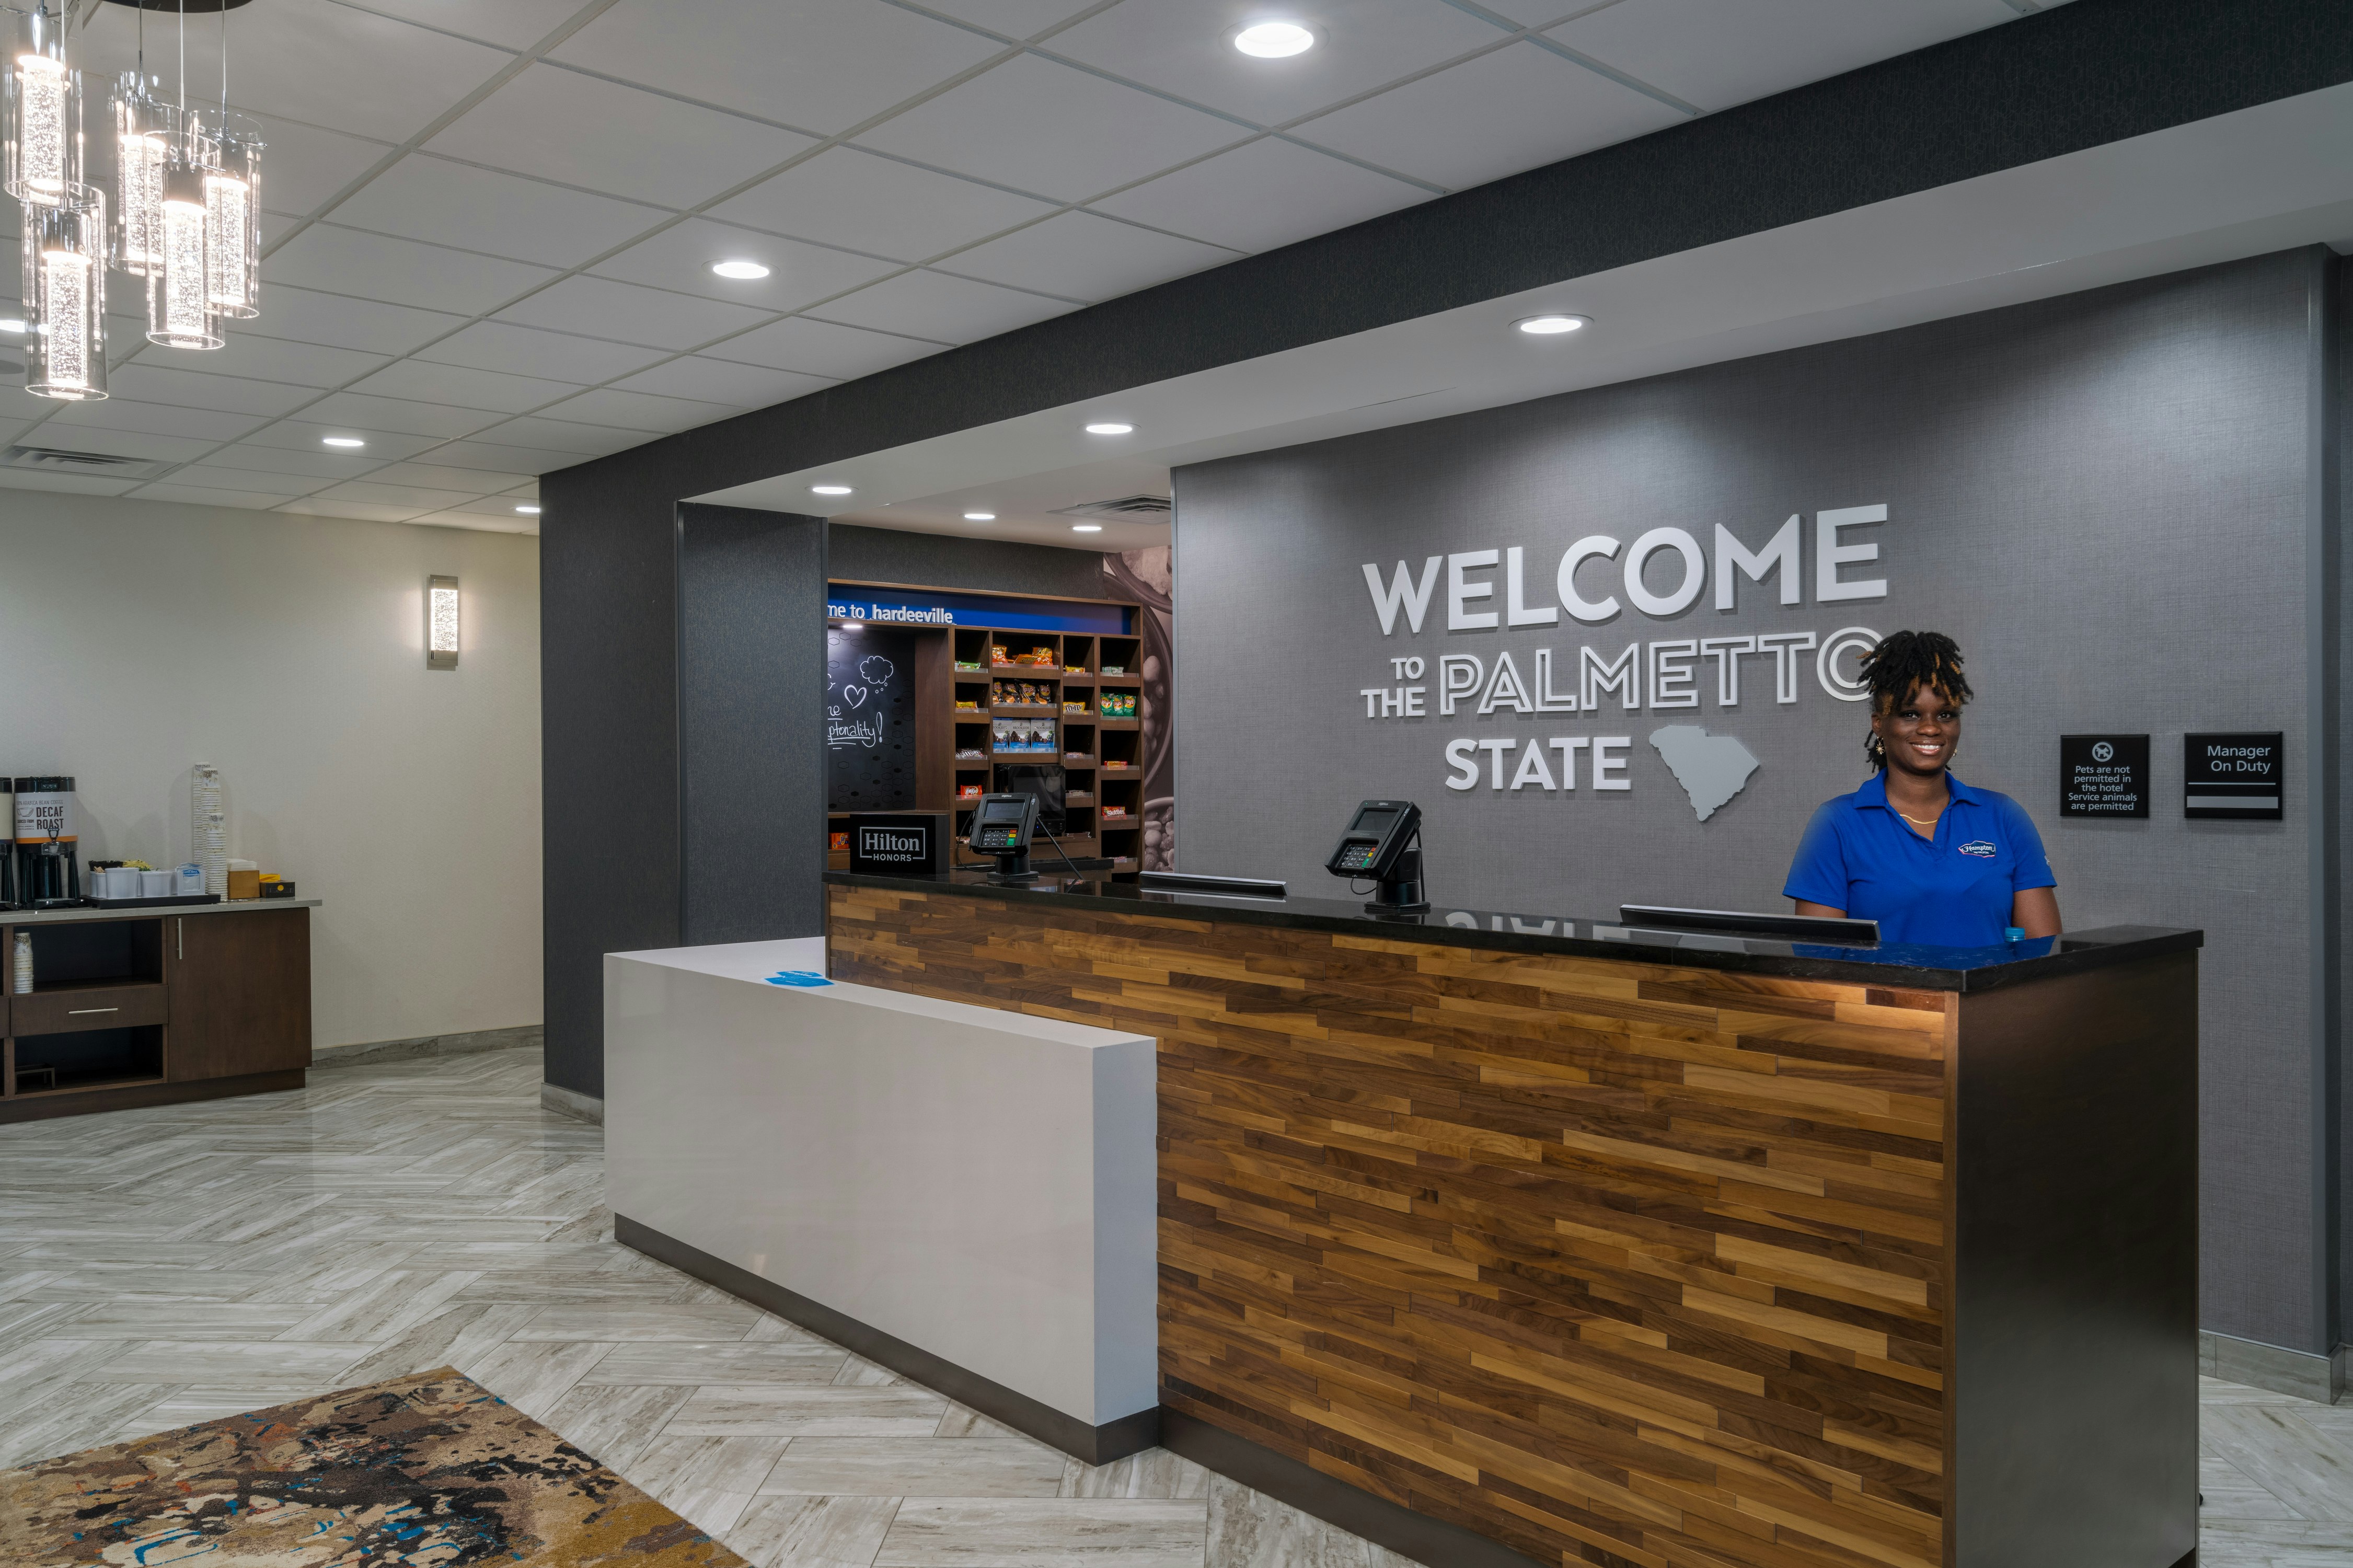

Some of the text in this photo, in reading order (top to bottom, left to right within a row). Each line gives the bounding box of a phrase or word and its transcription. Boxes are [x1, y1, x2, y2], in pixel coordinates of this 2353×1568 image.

[1362, 504, 1887, 636] WELCOME
[849, 604, 865, 619] to
[872, 604, 953, 624] hardeeville
[1360, 627, 1883, 718] THE PALMETTO
[1391, 656, 1425, 679] TO
[828, 712, 882, 747] ptonality!
[2208, 745, 2271, 759] Manager
[1445, 737, 1631, 790] STATE
[2211, 760, 2271, 774] On Duty
[2074, 774, 2119, 784] permitted
[2100, 783, 2124, 792] hotel
[2102, 793, 2137, 801] animals
[36, 806, 64, 817] DECAF
[2088, 802, 2134, 811] permitted
[37, 818, 64, 830] ROAST
[865, 833, 920, 851] Hilton
